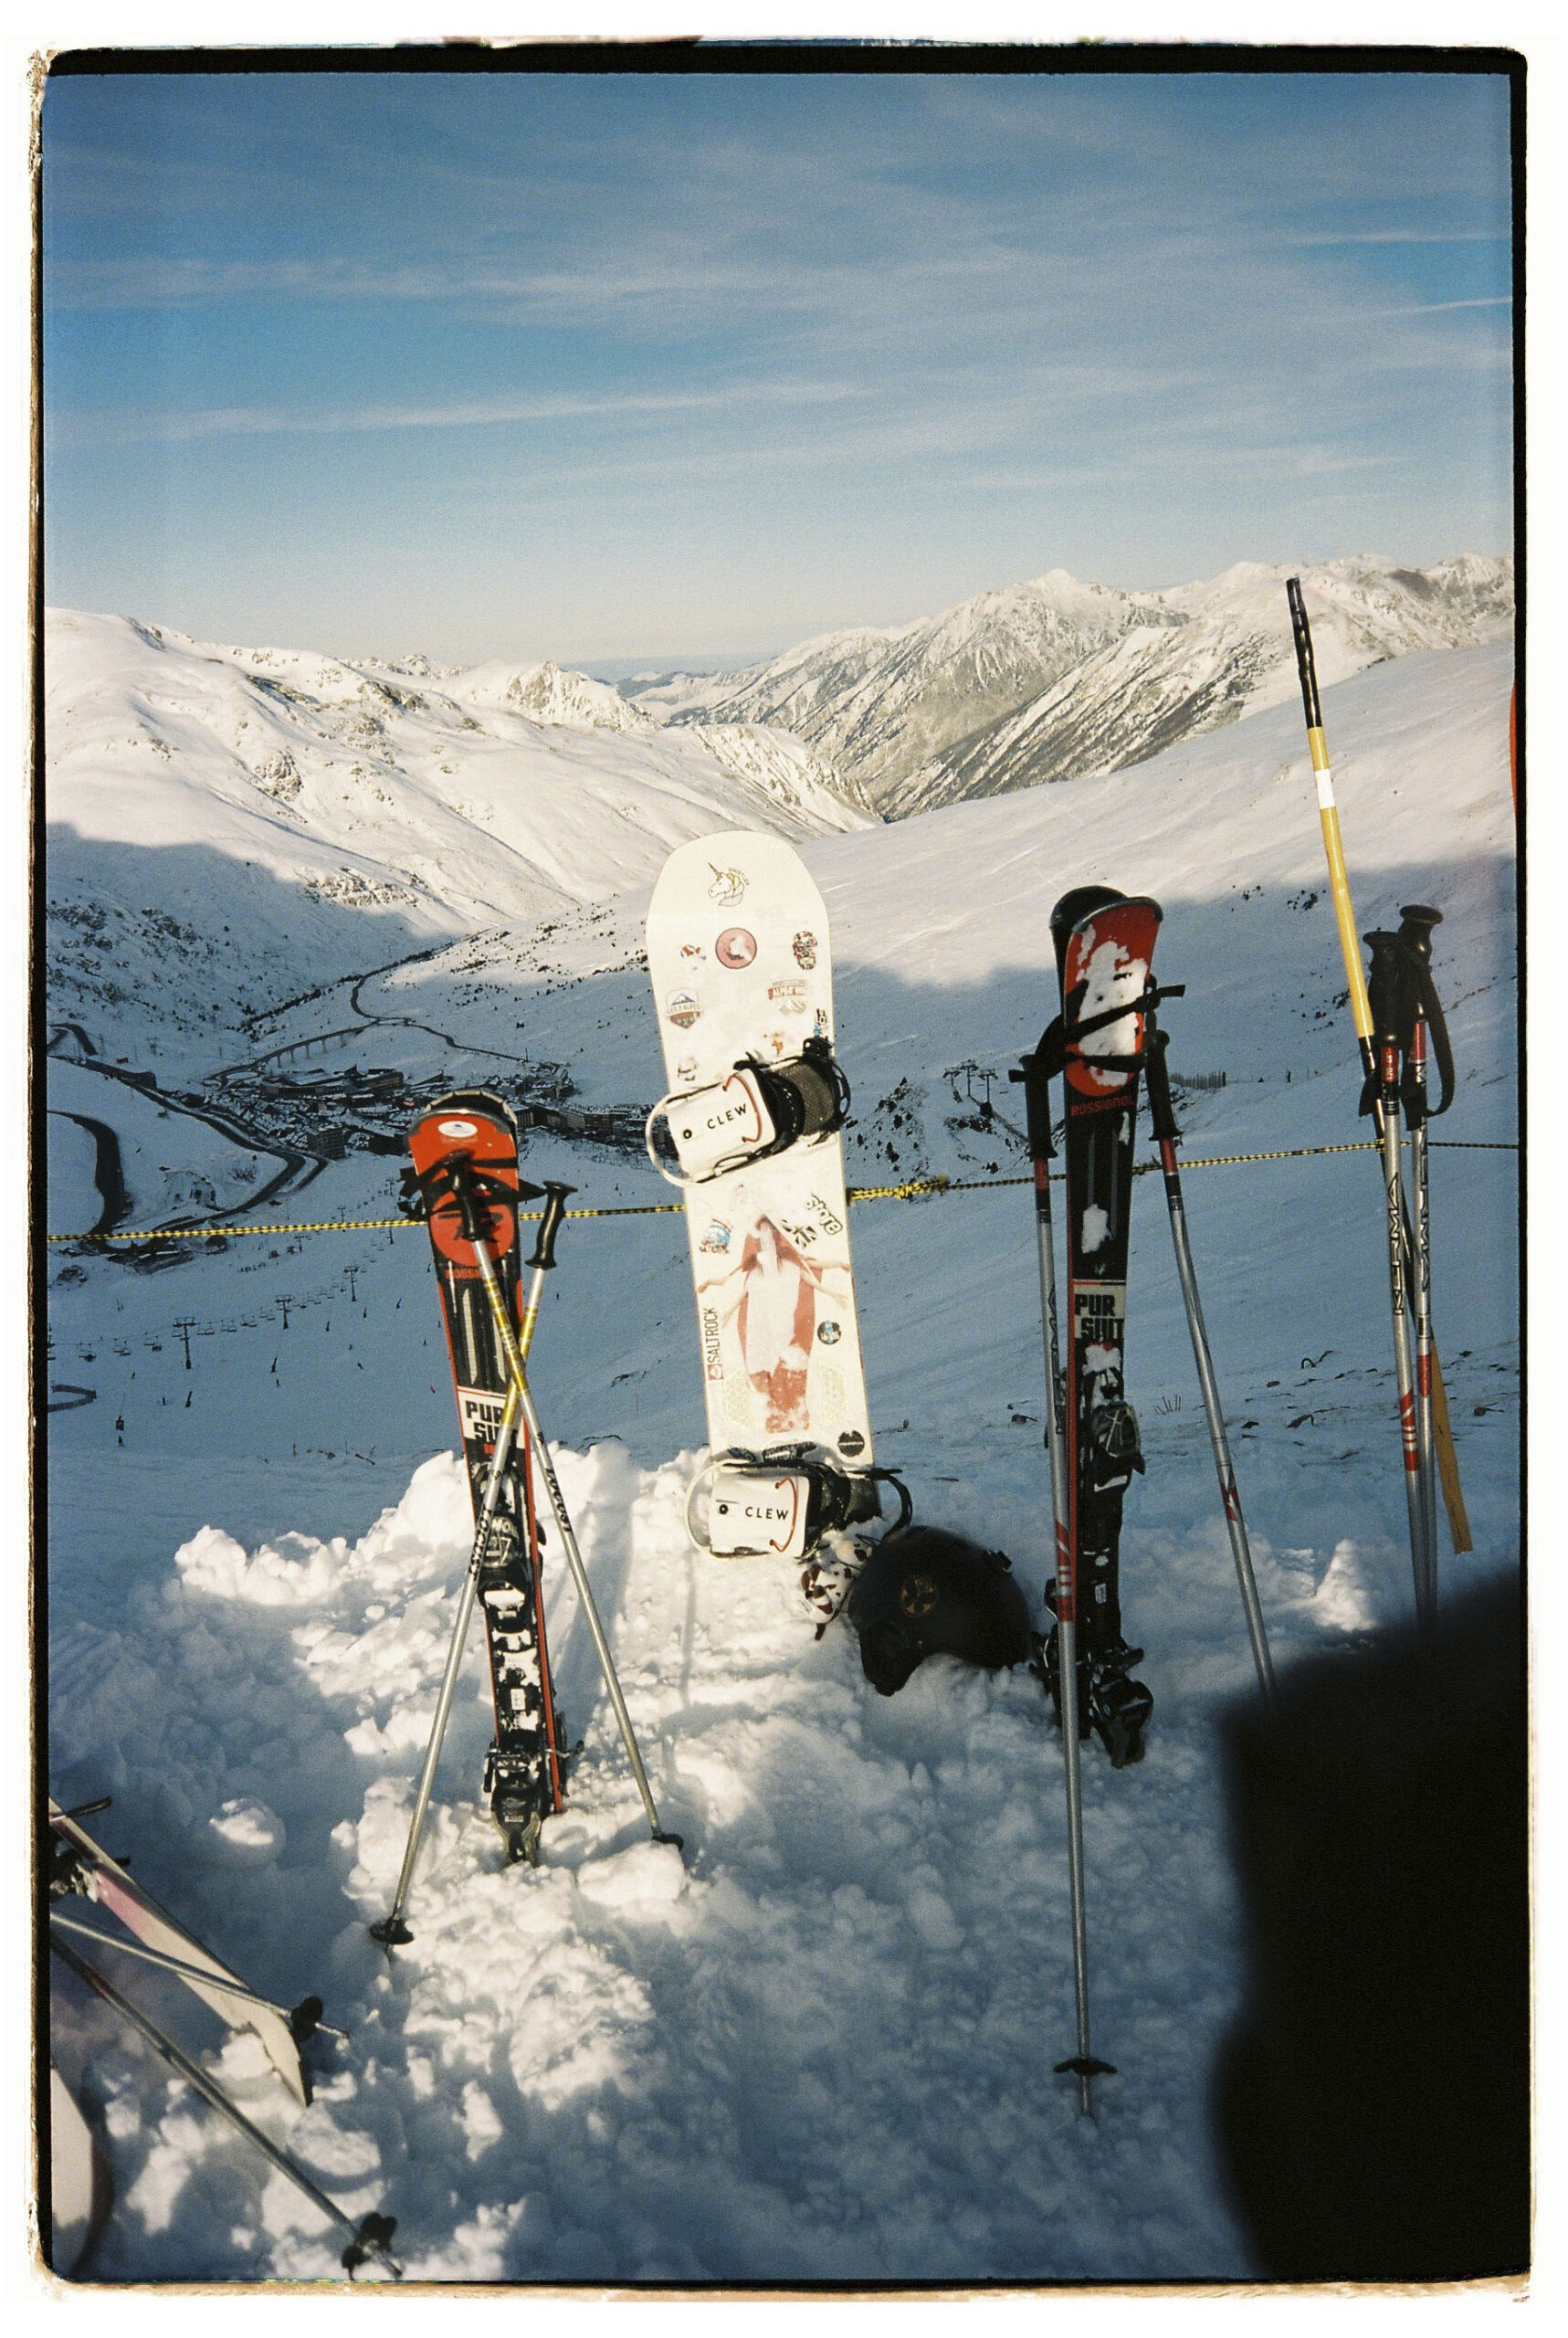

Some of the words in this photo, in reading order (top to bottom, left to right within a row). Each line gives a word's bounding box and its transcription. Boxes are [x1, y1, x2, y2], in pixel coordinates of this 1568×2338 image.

[707, 1103, 746, 1130] CLEW
[1387, 1172, 1405, 1316] KERMA
[1074, 1293, 1115, 1316] PUR
[702, 1308, 721, 1364] SALTROCK
[1080, 1317, 1125, 1341] SUIT
[745, 1506, 789, 1521] CLEW
